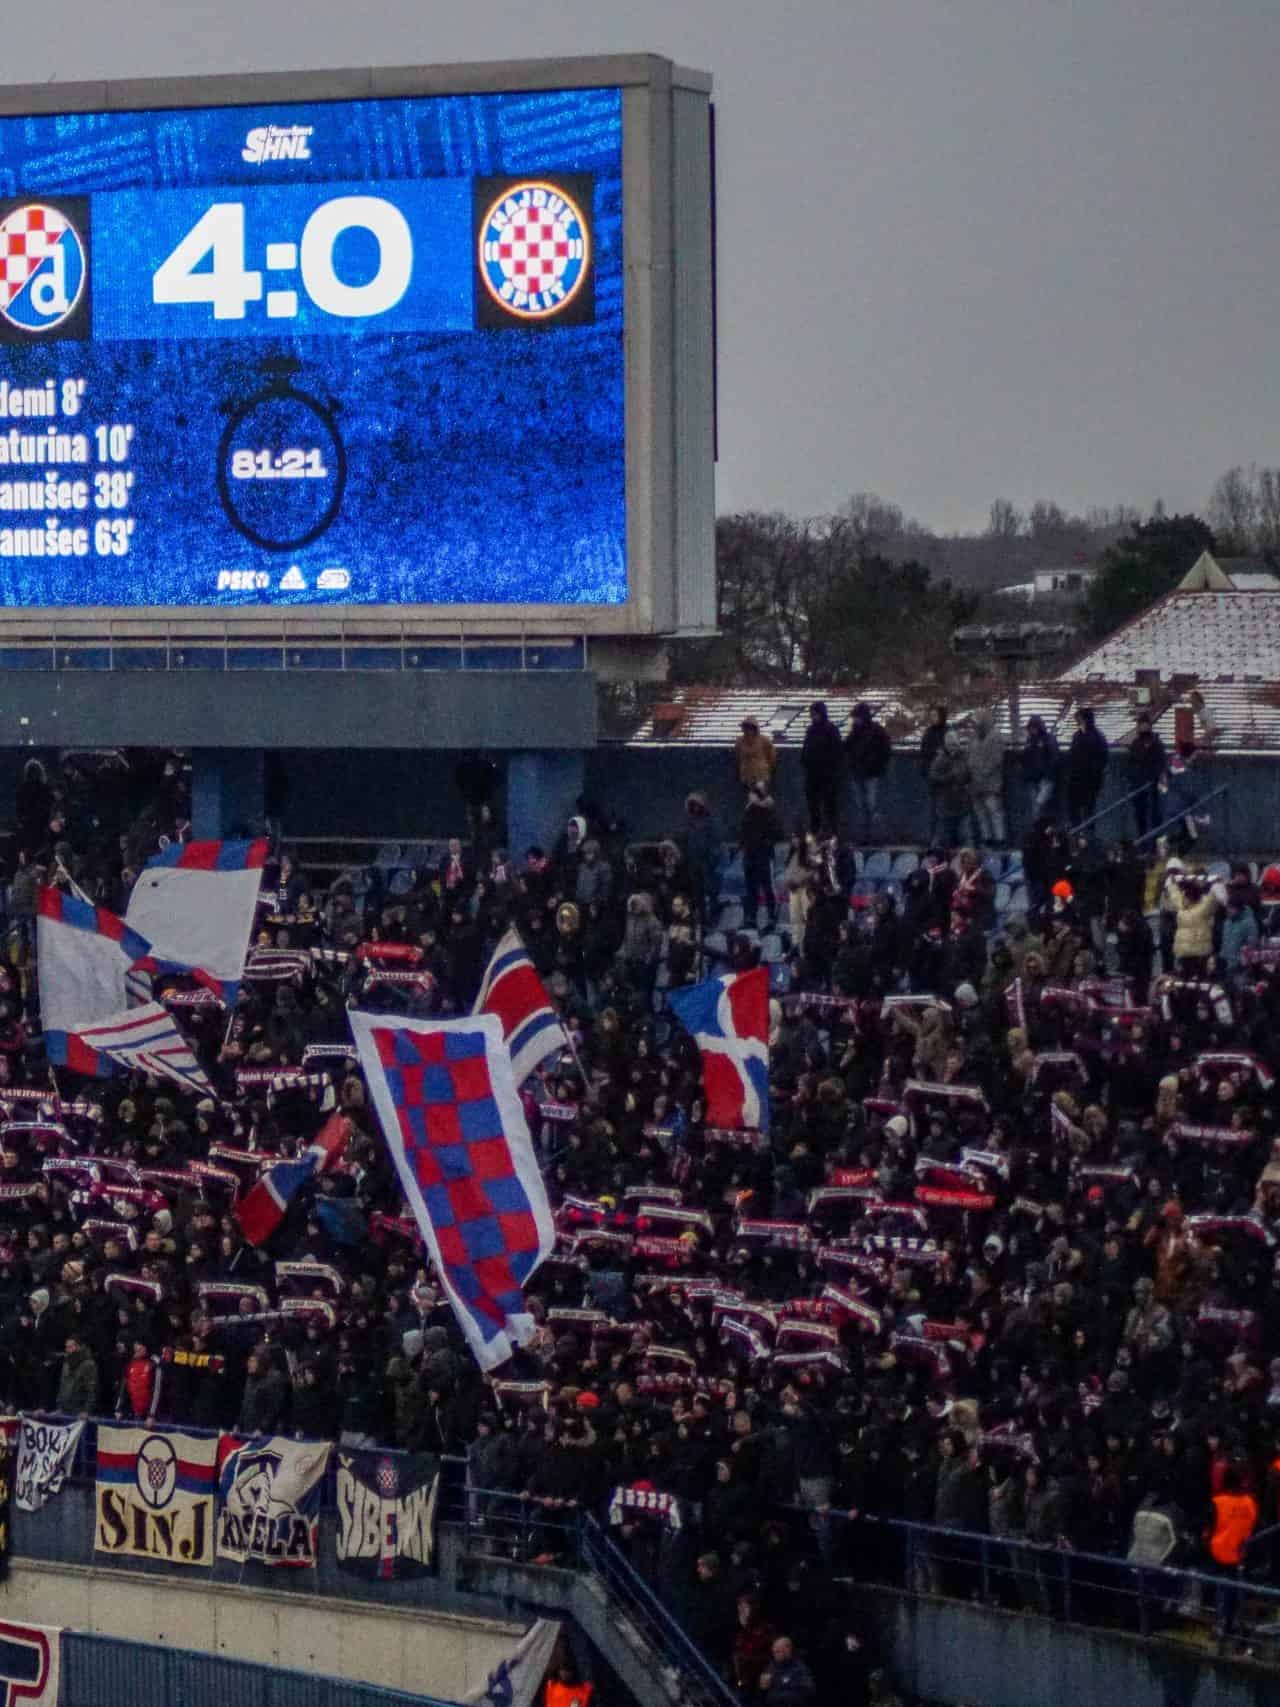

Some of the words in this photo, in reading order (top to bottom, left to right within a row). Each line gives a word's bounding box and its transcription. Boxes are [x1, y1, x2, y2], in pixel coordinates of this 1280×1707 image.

[490, 188, 577, 232] HAJDUK
[152, 196, 413, 320] 4:0
[499, 279, 566, 311] SPLIT
[94, 424, 135, 463] 10'
[94, 471, 135, 509] 38'
[94, 518, 136, 556] 63'
[100, 1487, 209, 1562] SINJ
